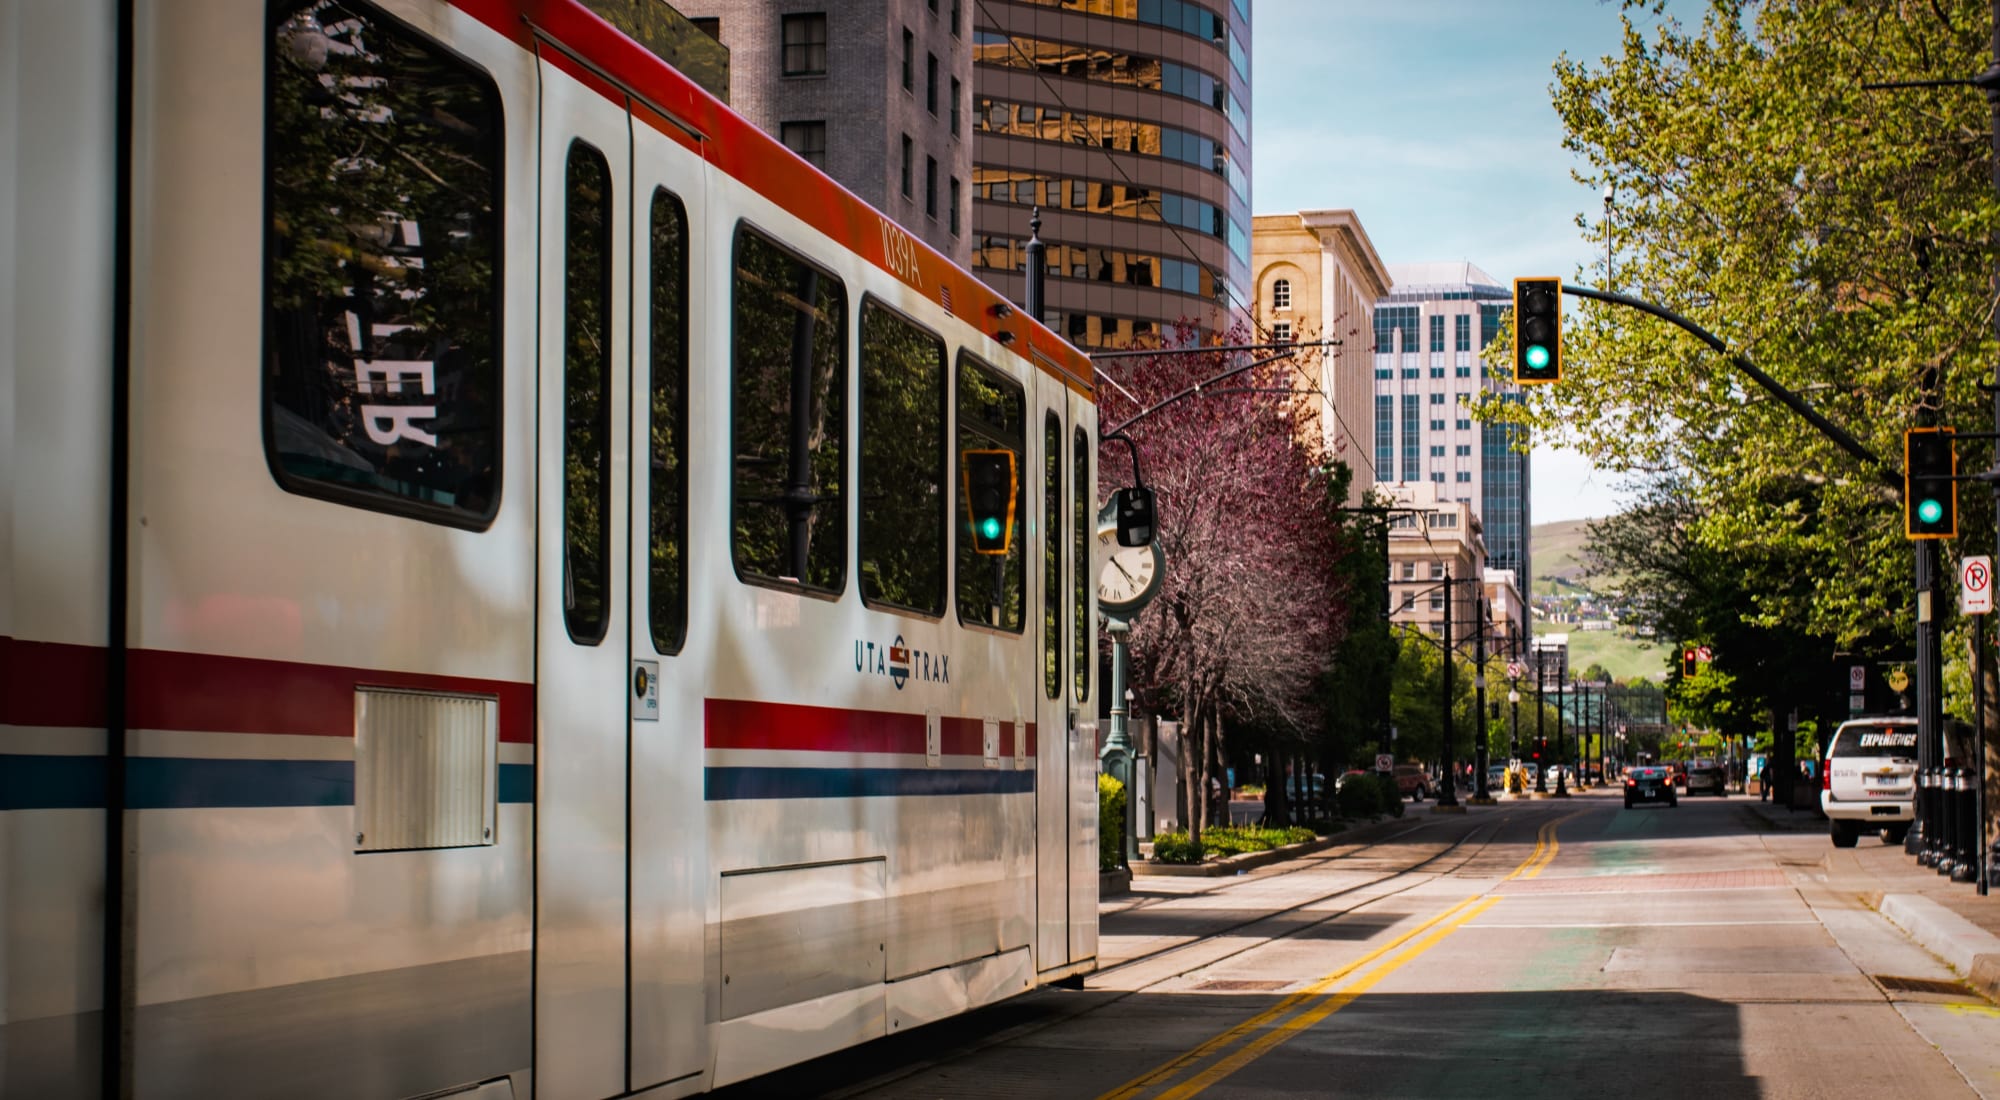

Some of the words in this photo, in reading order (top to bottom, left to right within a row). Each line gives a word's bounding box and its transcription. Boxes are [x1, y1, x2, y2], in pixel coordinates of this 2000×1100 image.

[879, 217, 922, 288] 1039A
[855, 639, 885, 676] UTA
[913, 649, 949, 684] TRAX
[1860, 733, 1917, 747] EXPERIENCE
